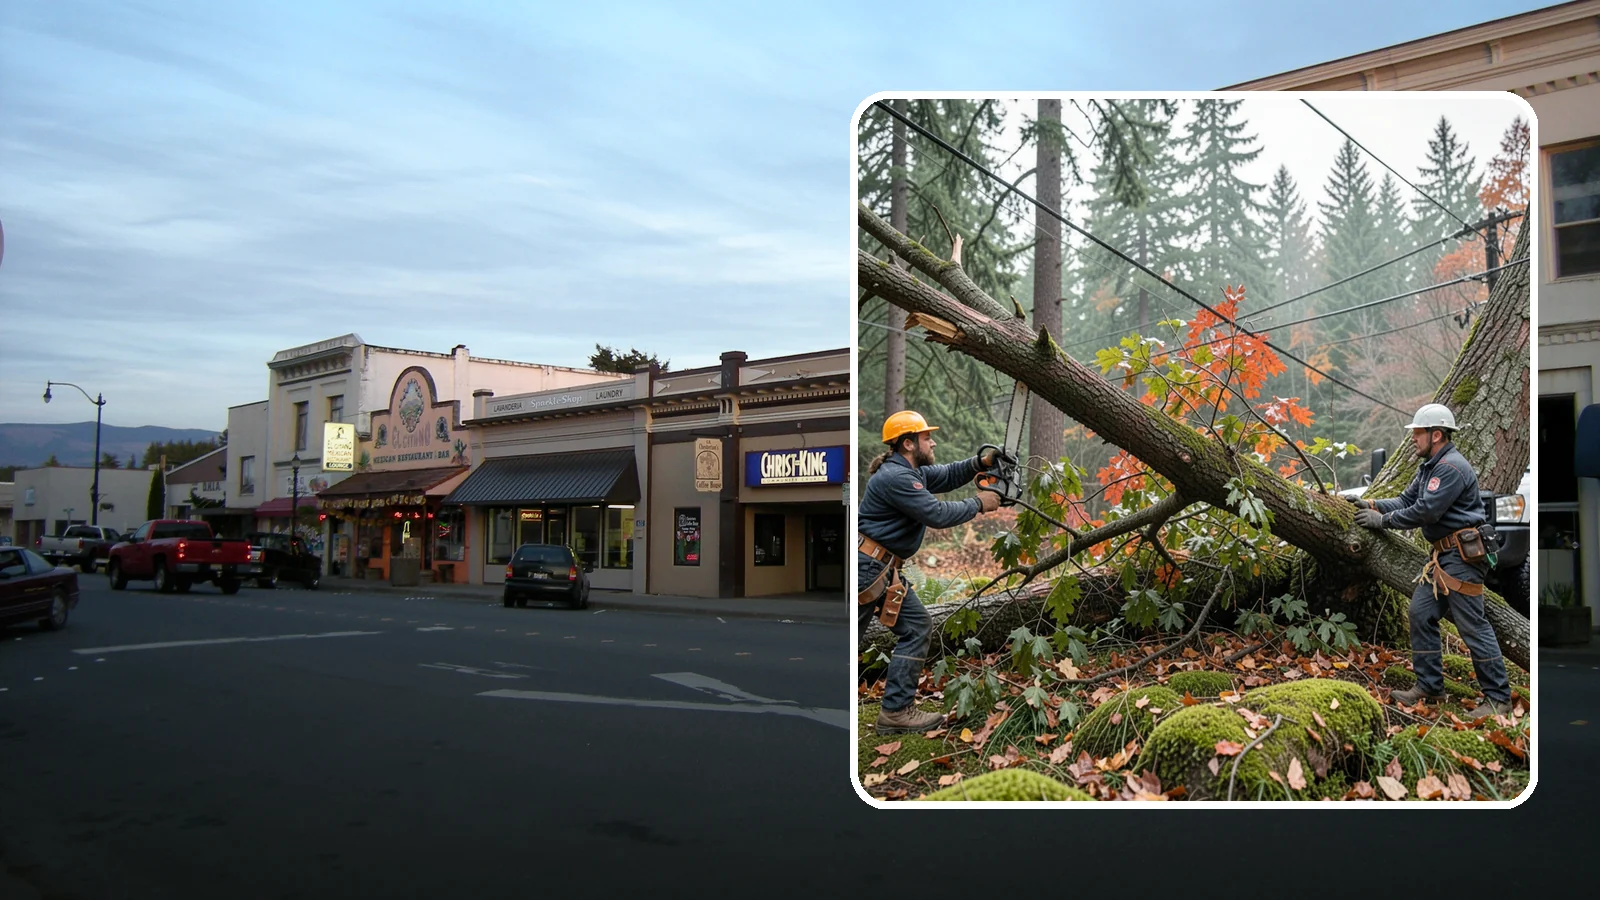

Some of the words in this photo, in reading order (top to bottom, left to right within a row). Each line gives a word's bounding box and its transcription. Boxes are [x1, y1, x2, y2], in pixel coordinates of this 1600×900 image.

[595, 389, 623, 400] LAUNDRY
[493, 402, 522, 412] LAVANDERIA
[397, 451, 433, 462] RESTAURANT
[438, 450, 450, 459] BAR
[761, 452, 797, 478] CHRIST
[799, 450, 827, 477] KING
